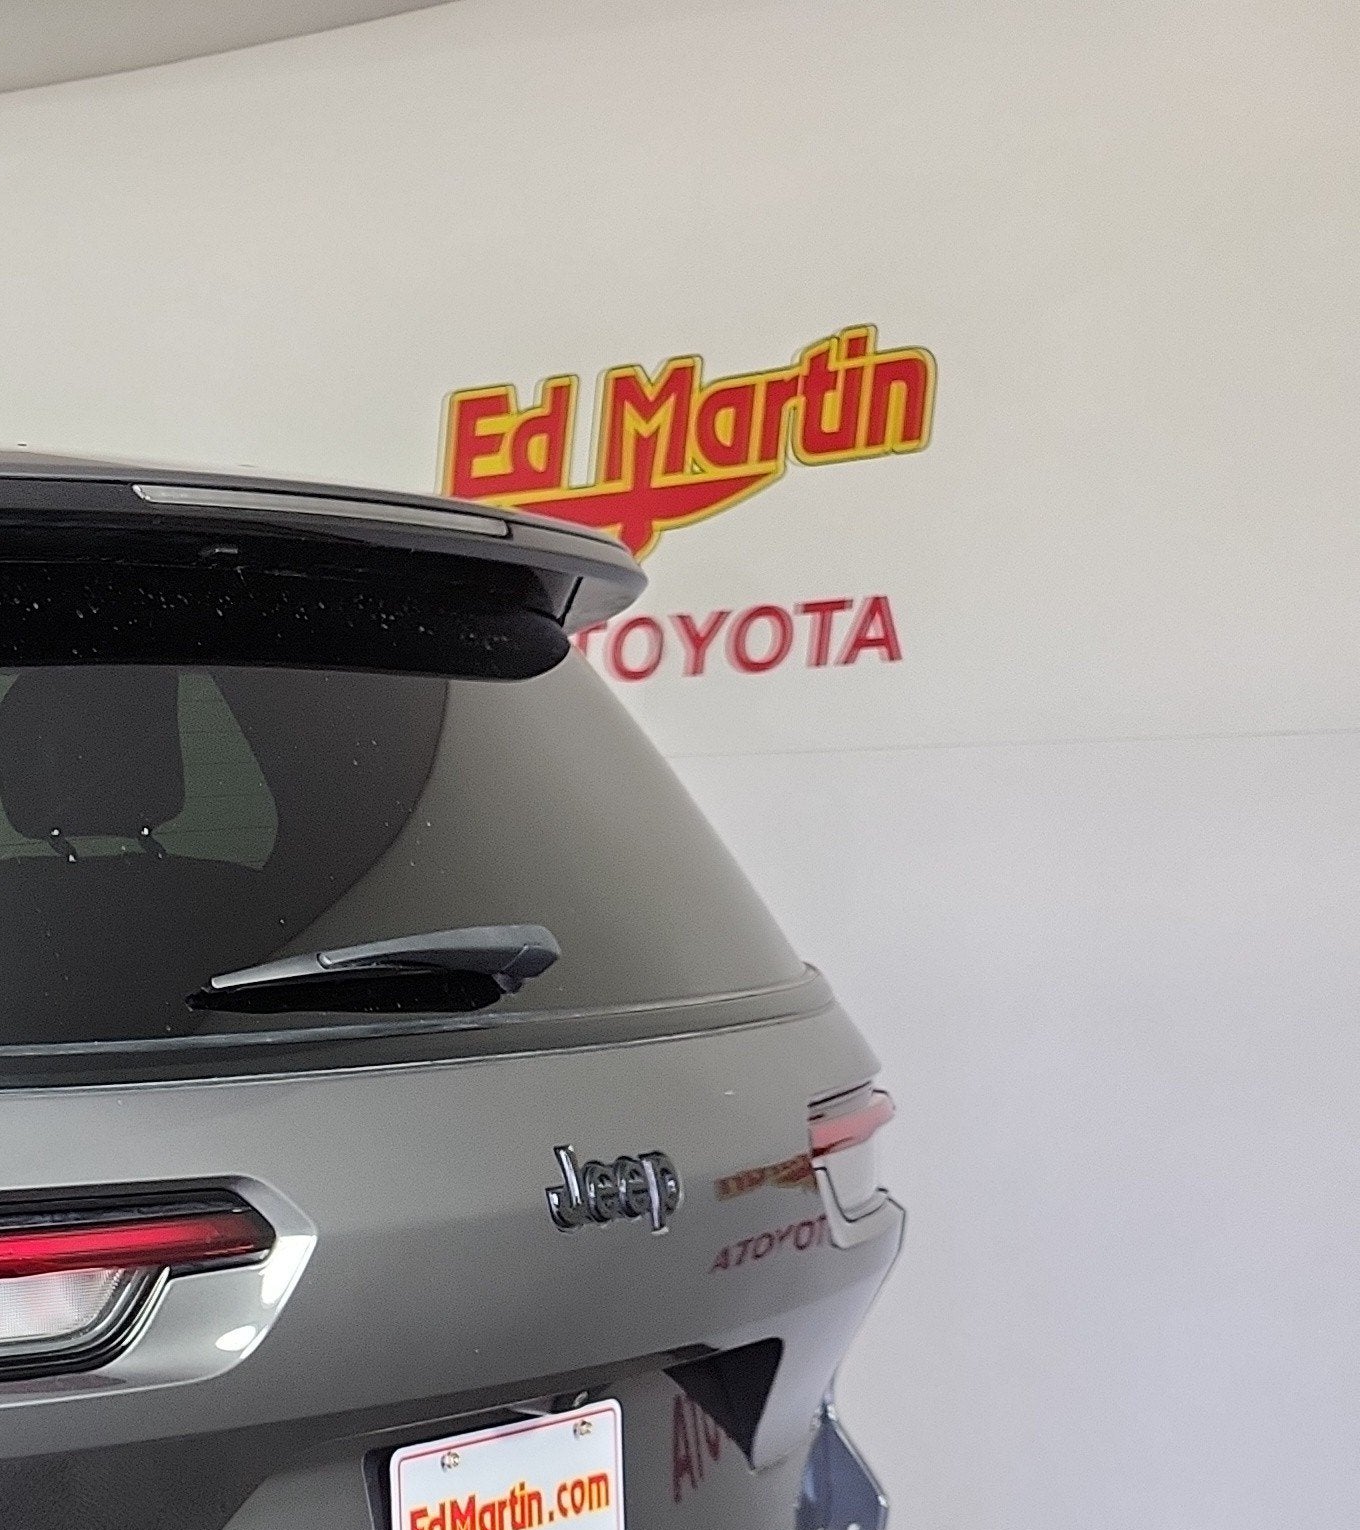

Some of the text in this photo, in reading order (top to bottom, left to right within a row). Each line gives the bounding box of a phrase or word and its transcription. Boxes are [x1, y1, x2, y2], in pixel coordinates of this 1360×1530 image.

[444, 325, 936, 499] Ed Martin
[545, 1144, 682, 1234] Jeep
